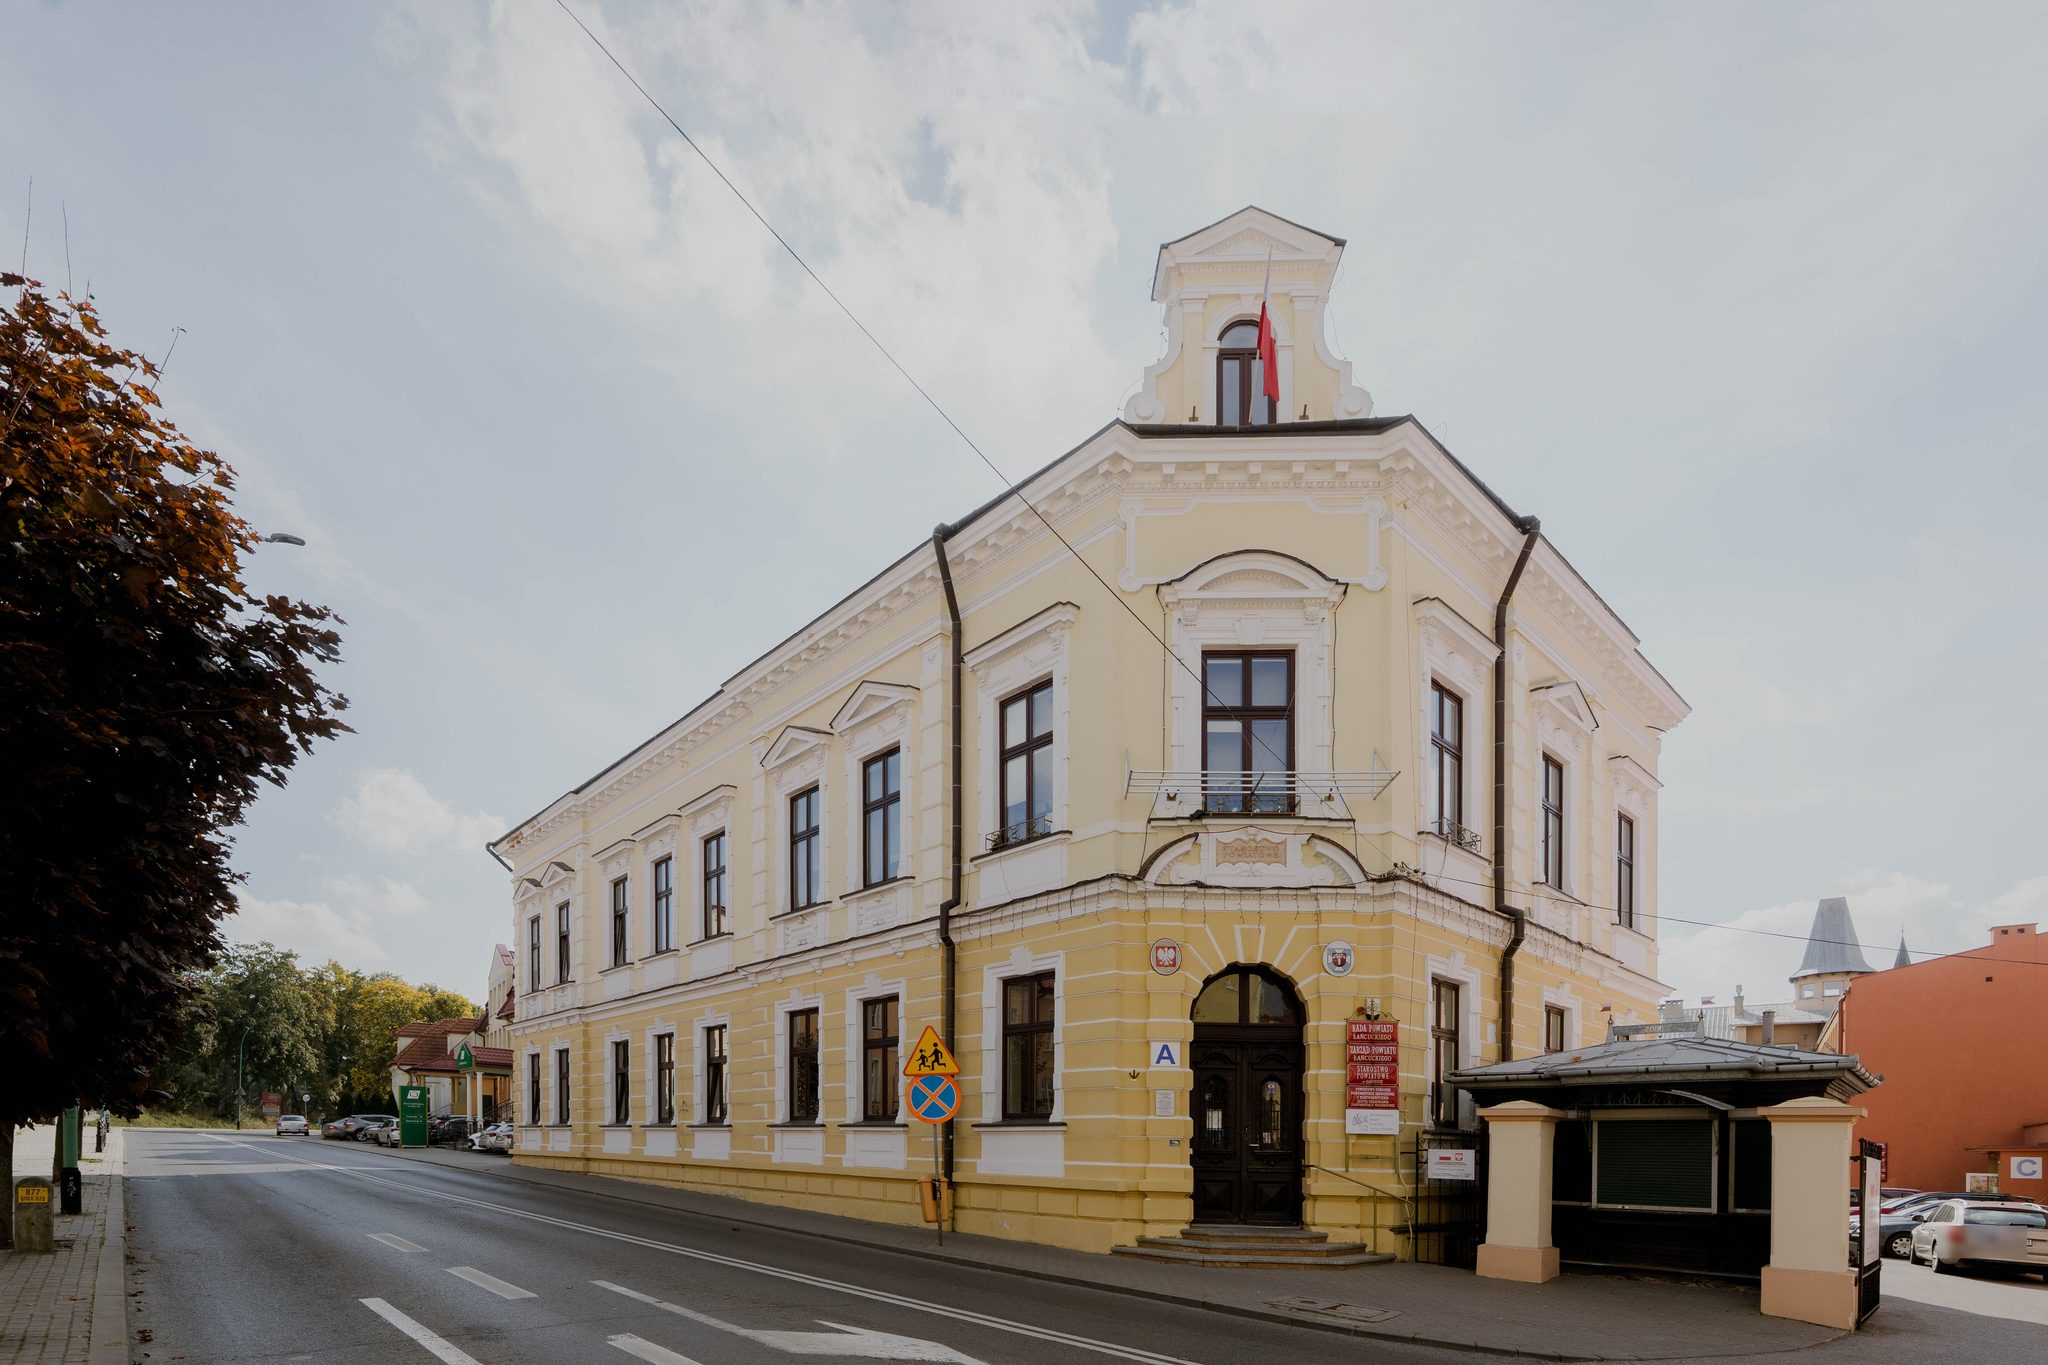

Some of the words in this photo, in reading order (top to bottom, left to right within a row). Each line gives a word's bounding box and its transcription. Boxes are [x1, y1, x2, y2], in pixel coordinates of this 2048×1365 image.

[1352, 1024, 1367, 1032] RADA
[1155, 1044, 1175, 1064] A
[1372, 1047, 1396, 1055] POWIATU
[1356, 1065, 1389, 1073] STAROSTWO
[2017, 1159, 2037, 1176] C
